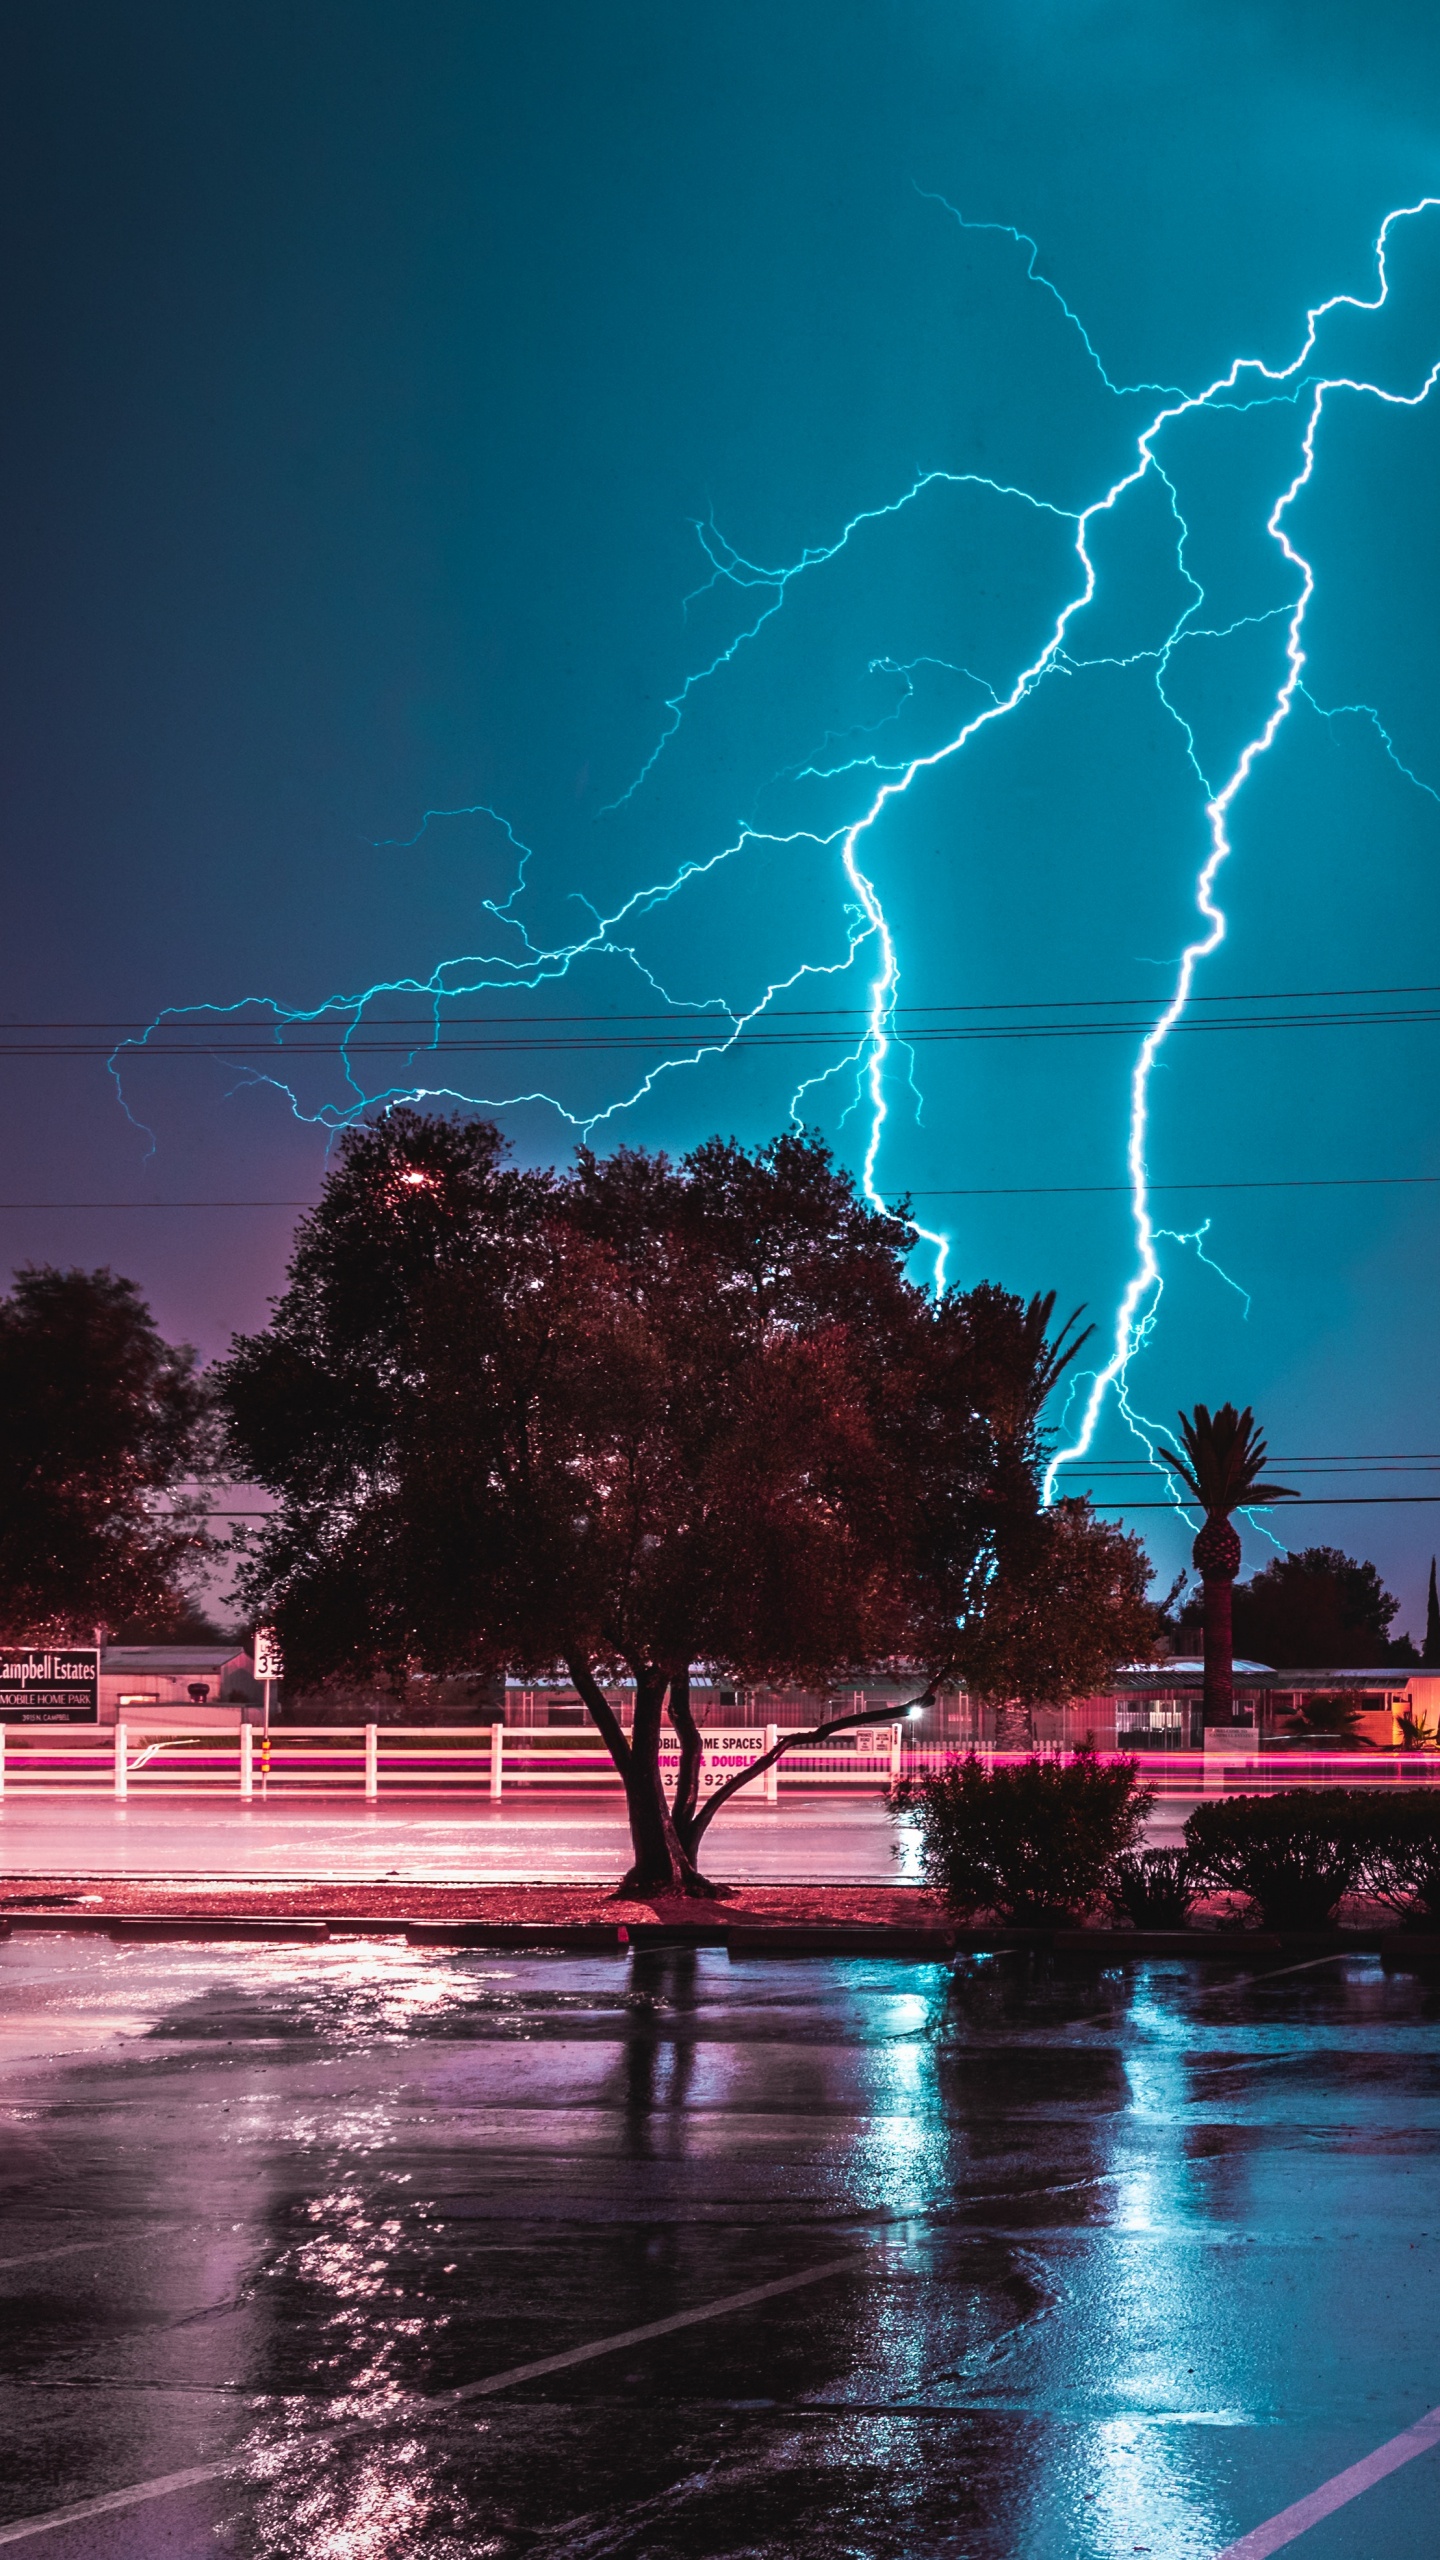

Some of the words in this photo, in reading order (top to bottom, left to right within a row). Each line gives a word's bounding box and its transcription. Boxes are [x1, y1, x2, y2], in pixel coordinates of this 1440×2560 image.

[54, 1656, 96, 1680] Estates
[0, 1694, 35, 1705] MOBILE
[37, 1694, 66, 1705] HOME
[68, 1694, 91, 1705] PARK
[704, 1738, 720, 1749] ME
[722, 1738, 763, 1749] SPACES
[711, 1755, 757, 1767] DOUBLE
